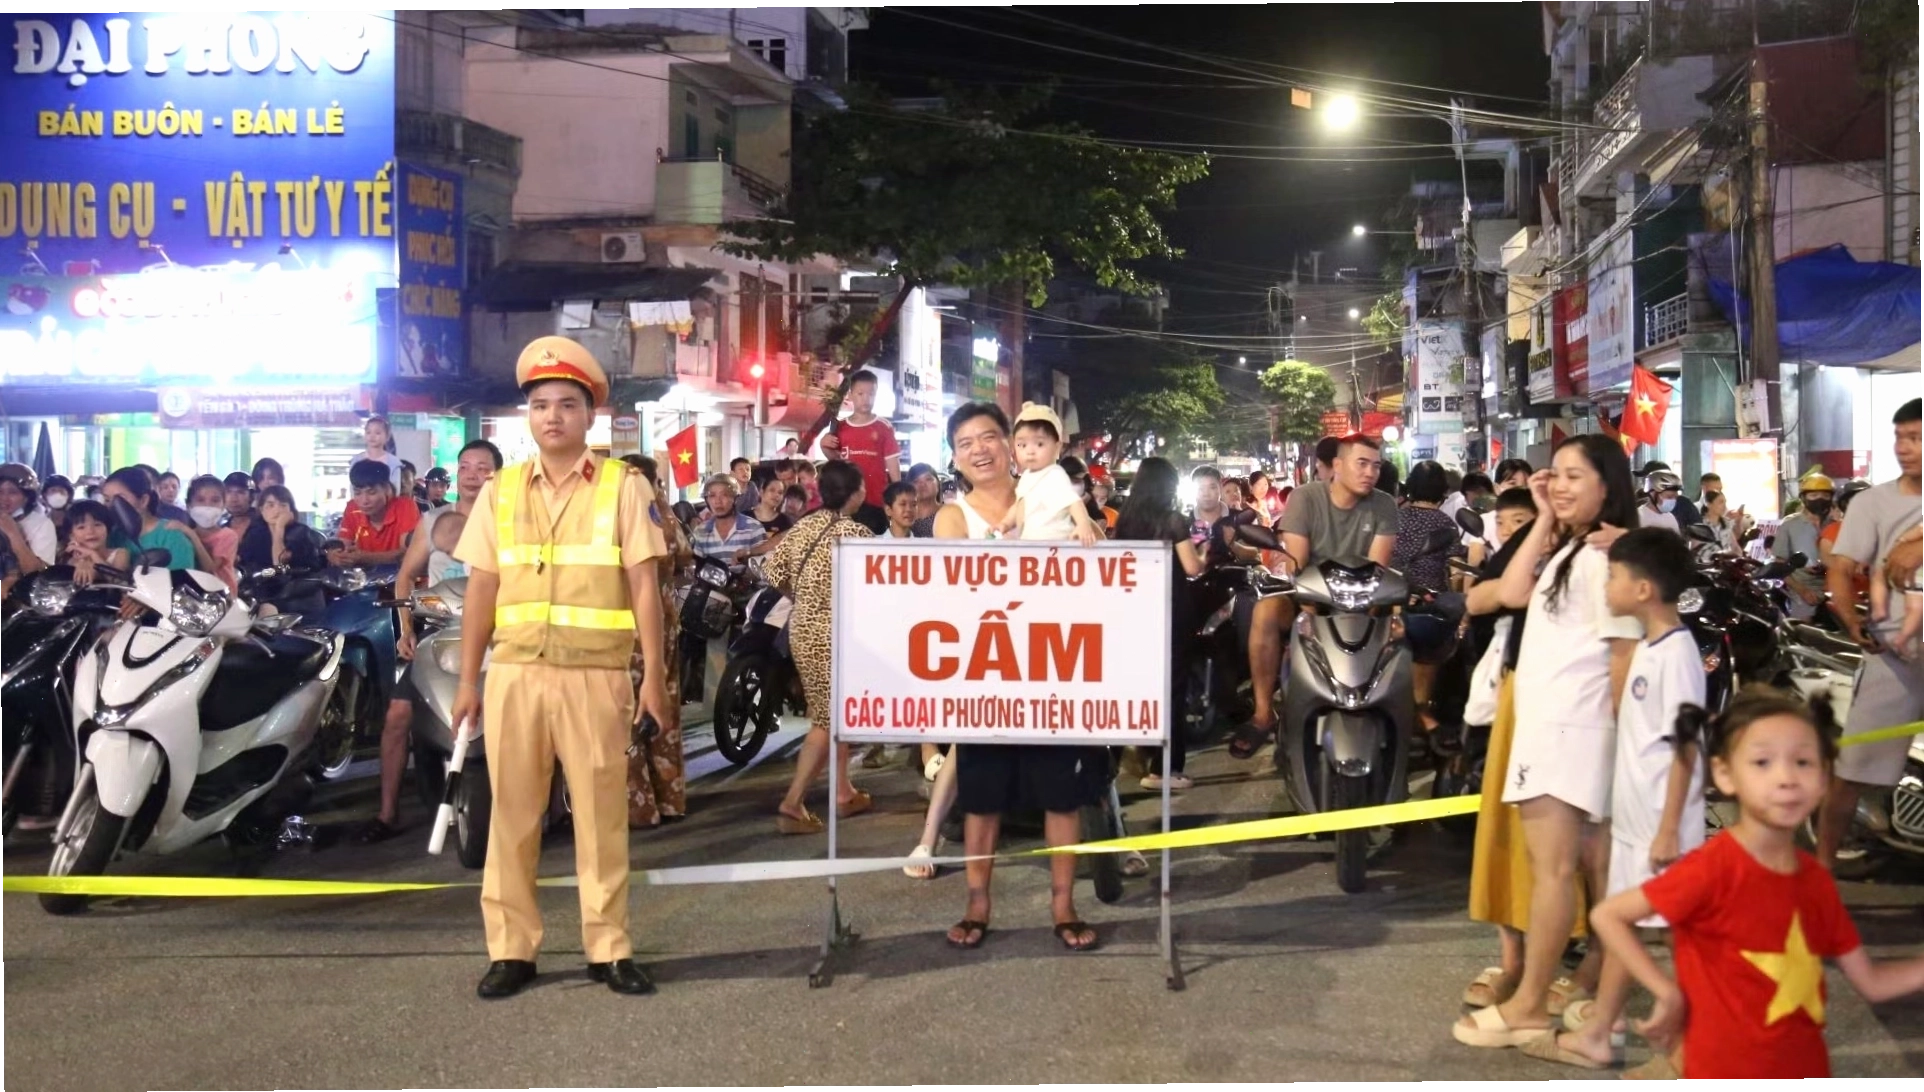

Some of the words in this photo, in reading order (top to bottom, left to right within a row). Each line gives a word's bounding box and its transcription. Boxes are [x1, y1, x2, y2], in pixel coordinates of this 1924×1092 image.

[13, 18, 132, 86] ĐẠI
[38, 103, 103, 136] BÁN
[112, 101, 203, 136] BUÔN
[232, 101, 297, 136] BÁN
[307, 100, 345, 136] LẺ
[0, 182, 97, 249] DỤNG
[108, 182, 155, 248] CỤ
[205, 171, 266, 248] VẬT
[275, 176, 321, 237] TƯ
[324, 181, 345, 237] Y
[354, 161, 392, 237] TẾ
[865, 555, 932, 585] KHU
[943, 553, 1008, 592] VỰC
[1019, 547, 1086, 587] BẢO
[1098, 551, 1137, 593] VỆ
[908, 601, 1102, 683] CẤM
[845, 690, 885, 728] CÁC
[892, 698, 936, 733] LOẠI
[943, 695, 1025, 729] PHƯƠNG
[1030, 694, 1074, 734] TIỆN
[1082, 700, 1121, 733] QUA
[1128, 700, 1158, 735] LẠI
